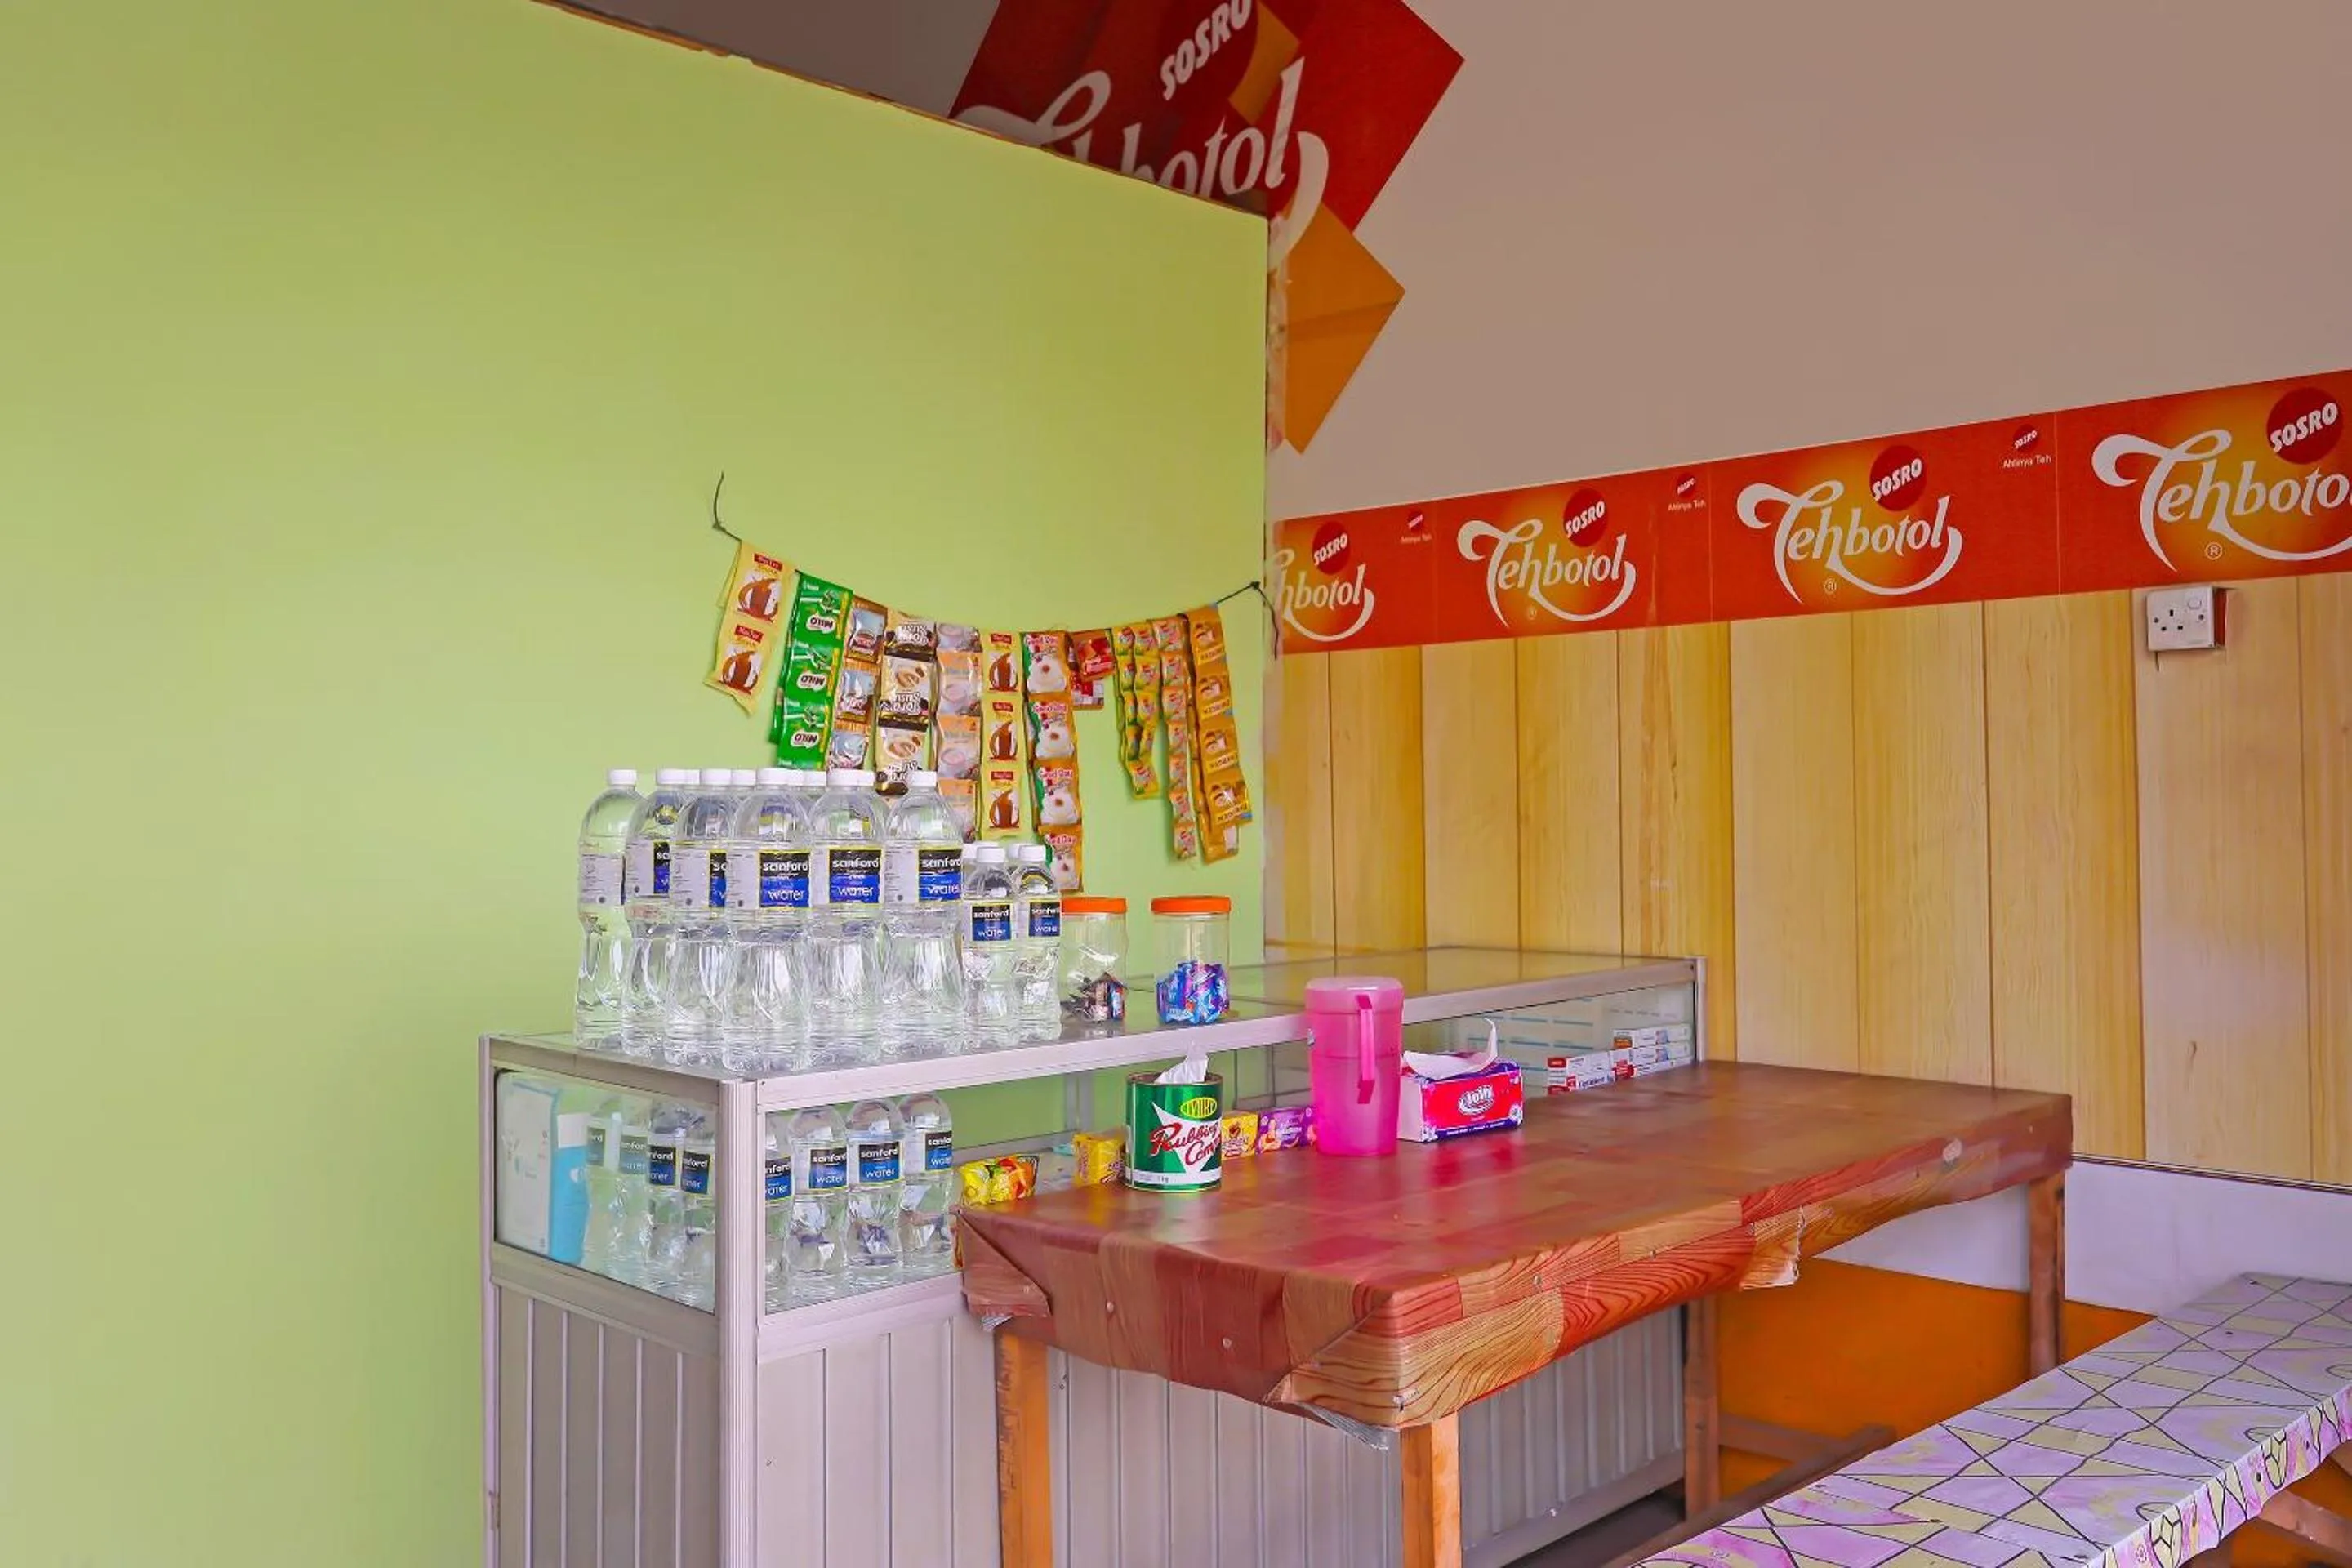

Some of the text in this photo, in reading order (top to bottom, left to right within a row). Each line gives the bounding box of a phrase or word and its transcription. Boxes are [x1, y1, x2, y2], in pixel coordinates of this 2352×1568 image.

[1160, 0, 1251, 101] SOSRO
[2270, 402, 2339, 452] SOSRO
[1870, 457, 1923, 503] SOSRO
[2091, 428, 2352, 572] Tehboto
[1565, 500, 1606, 538] SOSRO
[1313, 532, 1348, 567] SOSRO
[1737, 479, 1962, 605] Tehbotol
[1457, 518, 1637, 629] Tehbotol
[763, 861, 808, 871] sanford
[832, 858, 880, 868] sanford
[768, 889, 805, 901] water
[837, 887, 873, 897] water
[973, 908, 1009, 918] sanford
[861, 1147, 898, 1158] sanford
[866, 1168, 895, 1178] water
